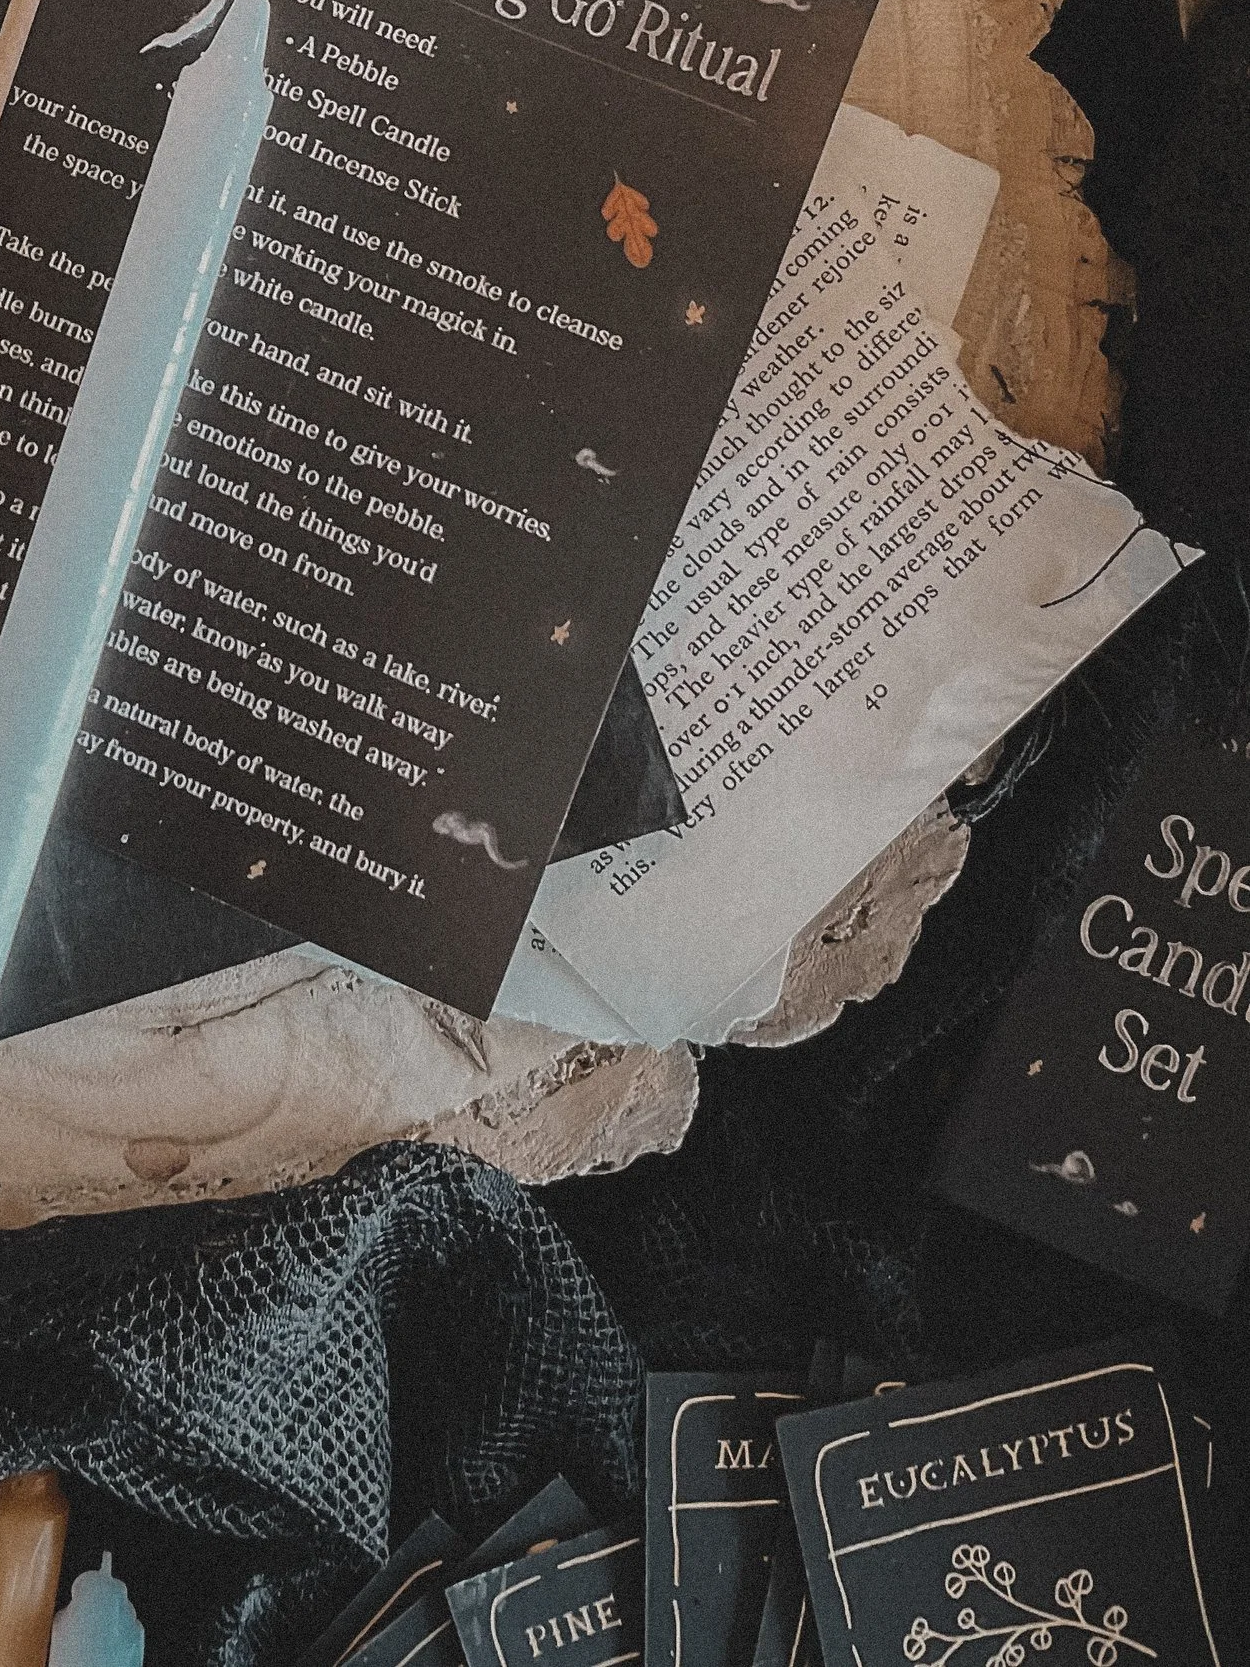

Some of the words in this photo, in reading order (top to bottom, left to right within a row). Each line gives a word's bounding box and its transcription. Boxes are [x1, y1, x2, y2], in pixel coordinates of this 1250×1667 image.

[319, 41, 399, 91] Pebble
[330, 0, 375, 31] will
[374, 19, 439, 58] need:
[624, 0, 782, 102] Ritual
[306, 87, 367, 128] Spell
[369, 114, 451, 162] Candle
[307, 137, 400, 192] Incense
[402, 177, 462, 219] Stick
[233, 267, 294, 306] white
[297, 296, 375, 341] candle.
[251, 229, 344, 286] working
[342, 269, 401, 304] your
[400, 293, 488, 342] magick
[489, 325, 518, 355] in.
[291, 204, 339, 235] and
[341, 223, 381, 252] use
[384, 239, 423, 269] the
[425, 259, 503, 302] smoke
[506, 288, 532, 313] to
[535, 303, 624, 351] cleanse
[247, 331, 311, 377] hand,
[315, 365, 363, 396] and
[362, 384, 393, 410] sit
[398, 398, 448, 434] with
[451, 417, 473, 445] it.
[739, 323, 825, 398] weather.
[185, 418, 293, 475] emotions
[295, 461, 320, 486] to
[323, 473, 363, 505] the
[363, 495, 445, 543] pebble.
[218, 383, 263, 416] this
[265, 402, 320, 440] time
[323, 427, 348, 452] to
[348, 443, 402, 475] give
[401, 464, 462, 499] your
[187, 510, 254, 551] move
[257, 541, 288, 567] on
[291, 551, 354, 597] from.
[196, 462, 250, 506] loud,
[254, 490, 294, 522] the
[297, 505, 372, 555] things
[627, 620, 680, 661] The
[683, 558, 743, 616] usual
[742, 516, 790, 559] type
[795, 479, 821, 511] of
[824, 443, 869, 485] rain
[873, 365, 950, 438] consists
[663, 669, 715, 711] The
[709, 599, 787, 671] heavier
[786, 557, 834, 601] type
[834, 525, 860, 557] of
[858, 461, 931, 535] rainfall
[928, 422, 975, 469] may
[172, 567, 203, 590] of
[271, 610, 328, 649] such
[330, 636, 359, 660] as
[361, 649, 378, 669] a
[721, 741, 775, 792] often
[776, 702, 814, 737] the
[811, 640, 876, 701] larger
[880, 583, 939, 639] drops
[941, 537, 987, 579] that
[986, 487, 1044, 537] form
[162, 655, 202, 684] are
[205, 668, 273, 721] being
[276, 703, 363, 757] washed
[363, 745, 428, 787] away.
[189, 615, 257, 660] know
[255, 650, 284, 674] as
[282, 661, 330, 695] you
[335, 682, 388, 721] walk
[390, 709, 454, 751] away
[863, 681, 890, 713] 40
[86, 687, 102, 705] a
[102, 694, 181, 740] natural
[181, 723, 236, 766] body
[235, 753, 264, 775] of
[327, 791, 365, 821] the
[102, 736, 158, 778] from
[157, 765, 212, 800] your
[308, 833, 353, 865] and
[353, 848, 407, 891] bury
[406, 872, 426, 900] it.
[608, 858, 656, 897] this.
[1078, 893, 1250, 1024] Cand
[1096, 1007, 1207, 1103] Set
[856, 1407, 1135, 1510] EUCALYPTUS
[524, 1591, 623, 1658] PINE
